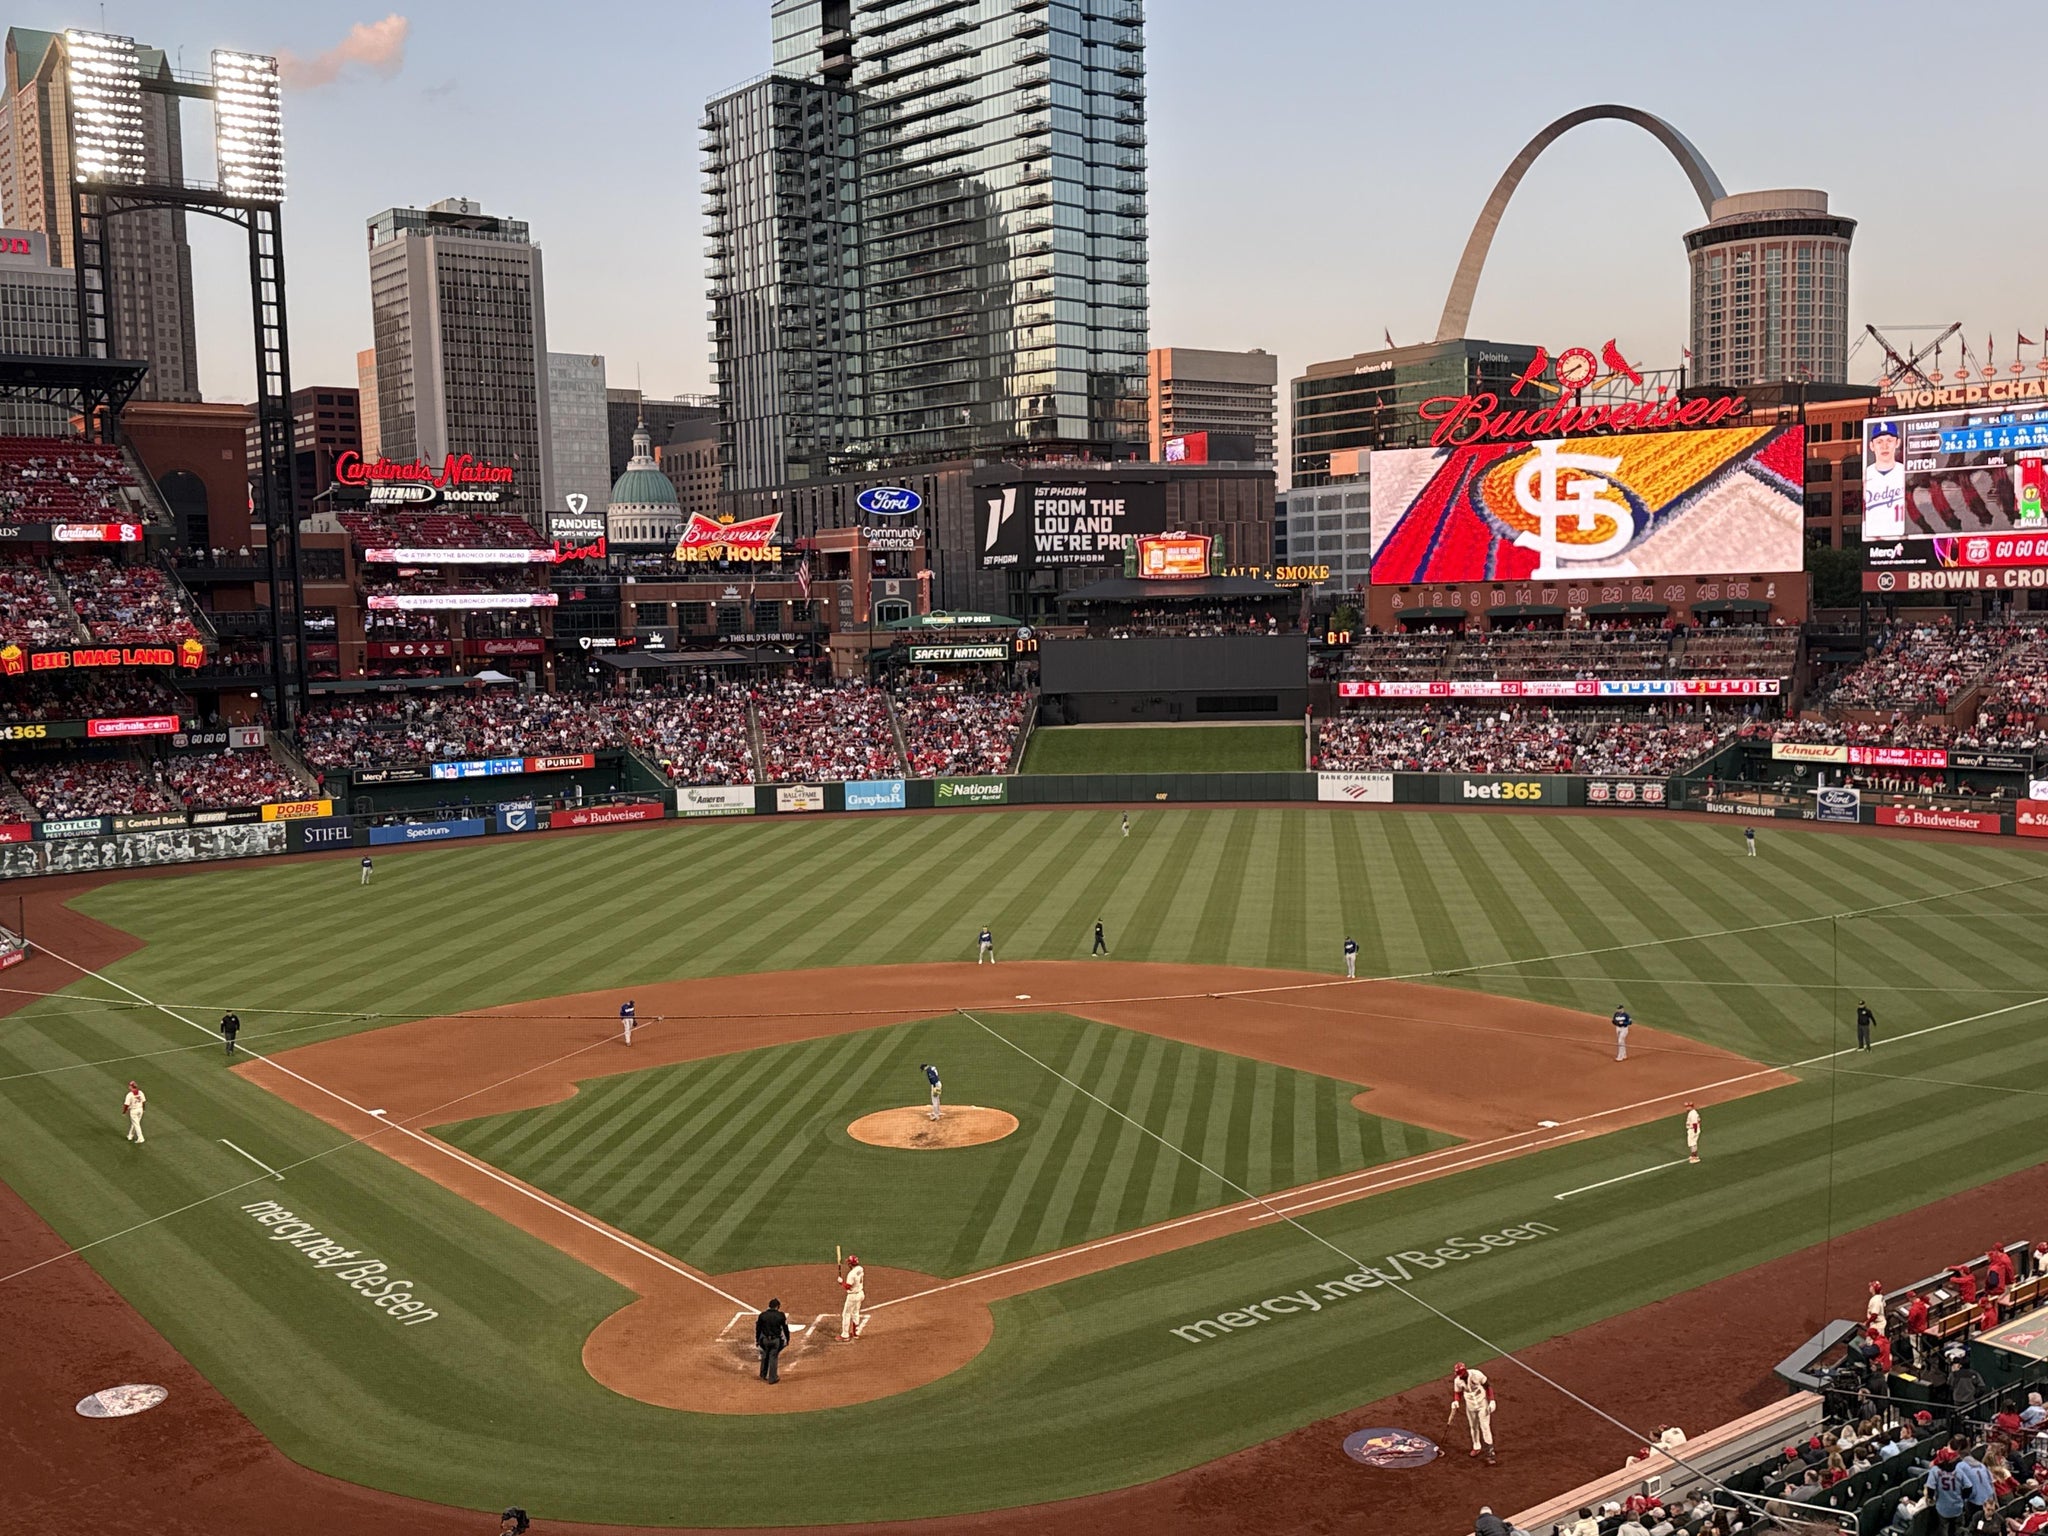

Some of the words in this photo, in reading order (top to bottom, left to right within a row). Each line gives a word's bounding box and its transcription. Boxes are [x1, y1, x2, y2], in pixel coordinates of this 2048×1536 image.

[1355, 364, 1381, 375] Anthem
[1894, 386, 1982, 409] WORLD
[1419, 387, 1747, 447] Budweiser
[1915, 421, 1939, 431] SASAKI
[1945, 441, 1963, 450] 26.2
[1967, 440, 1977, 449] 33
[1984, 438, 1993, 447] 15
[1999, 437, 2010, 446] 26
[1907, 459, 1936, 470] PITCH
[1988, 457, 2004, 465] MPH
[336, 450, 433, 486] Cardinals
[432, 453, 513, 488] Nation
[370, 486, 425, 499] HOFFMANN
[444, 491, 499, 501] ROOFTOP
[1050, 487, 1087, 496] PHORM
[871, 490, 910, 510] Ford
[1034, 499, 1086, 516] FROM
[1090, 499, 1125, 516] THE
[552, 518, 605, 529] FANDUEL
[1034, 517, 1069, 534] LOU
[1073, 516, 1112, 533] AND
[55, 524, 103, 541] Cardinals
[675, 523, 777, 545] Budweiser
[863, 527, 922, 539] Community
[676, 547, 724, 562] BREW
[727, 546, 782, 562] HOUSE
[1870, 547, 1897, 559] Mercy
[1970, 549, 1985, 559] 66
[1996, 541, 2013, 558] GO
[2015, 540, 2033, 557] GO
[1276, 565, 1330, 580] SMOKE
[1908, 571, 1979, 589] BROWN
[1985, 574, 1998, 588] &
[2004, 568, 2048, 587] CRO
[1490, 590, 1506, 605] 10
[1515, 590, 1531, 605] 14
[1542, 589, 1558, 604] 17
[1568, 588, 1589, 604] 20
[1602, 588, 1622, 603] 23
[1632, 586, 1653, 602] 24
[1663, 585, 1685, 601] 42
[1697, 584, 1719, 600] 45
[1727, 583, 1749, 599] 85
[1419, 593, 1424, 607] 1
[1433, 592, 1442, 607] 2
[1451, 591, 1461, 606] 6
[1470, 591, 1481, 606] 9
[730, 634, 745, 643] THIS
[746, 634, 766, 642] BUD'S
[782, 633, 795, 641] YOU
[1327, 631, 1350, 645] 0:17
[32, 652, 70, 671] BIG
[74, 650, 121, 667] MAC
[123, 649, 174, 665] LAND
[914, 649, 951, 660] SAFETY
[953, 647, 1003, 658] NATIONAL
[1503, 684, 1516, 693] 2-2
[98, 719, 170, 733] cardinals.com
[192, 734, 202, 744] GO
[204, 733, 215, 743] GO
[216, 732, 227, 743] GO
[1777, 744, 1840, 757] Schnucks
[547, 758, 583, 767] PURINA
[1957, 757, 1978, 767] Mercy
[362, 772, 383, 782] Mercy
[1355, 774, 1391, 782] AMERICA
[953, 783, 1003, 796] National
[1464, 780, 1542, 800] bet365
[1619, 790, 1632, 798] 66
[1646, 791, 1659, 799] 66
[696, 795, 725, 804] Ameren
[1826, 791, 1850, 804] Ford
[277, 803, 319, 815] DOBBS
[499, 801, 533, 812] CarShield
[1707, 803, 1734, 814] BUSCH
[1737, 805, 1775, 817] STADIUM
[127, 819, 161, 828] Central
[162, 815, 186, 825] Bank
[590, 809, 646, 824] Budweiser
[1913, 812, 1980, 829] Budweiser
[45, 821, 99, 832] ROTTLER
[63, 829, 99, 838] SOLUTIONS
[406, 827, 447, 839] Spectrum
[304, 826, 352, 843] STIFEL
[241, 1200, 439, 1326] mercy.net/BeSeen
[1169, 1219, 1560, 1344] mercy.net/BeSeen
[1942, 1477, 1957, 1491] 51
